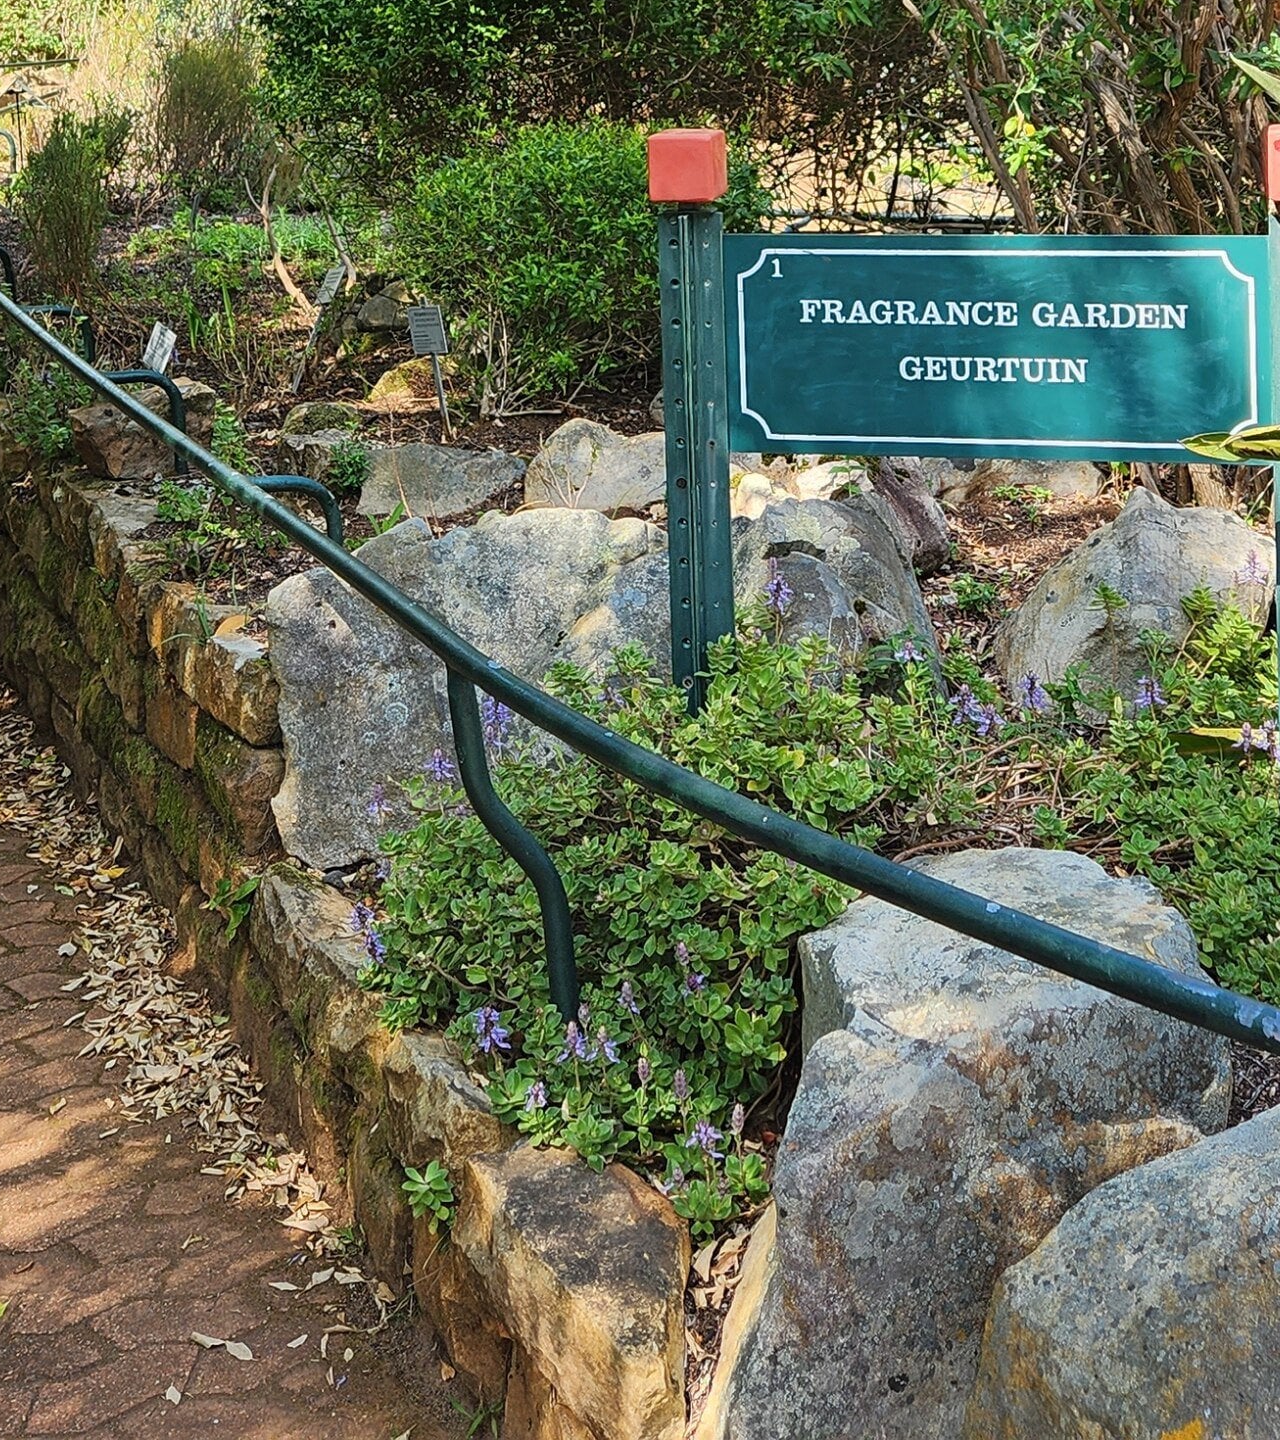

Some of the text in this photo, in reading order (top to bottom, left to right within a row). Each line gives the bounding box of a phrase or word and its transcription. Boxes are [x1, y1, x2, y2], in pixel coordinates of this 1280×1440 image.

[771, 258, 784, 278] 1
[799, 299, 1189, 329] FRAGRANCE GARDEN
[899, 356, 1089, 383] GEURTUIN
